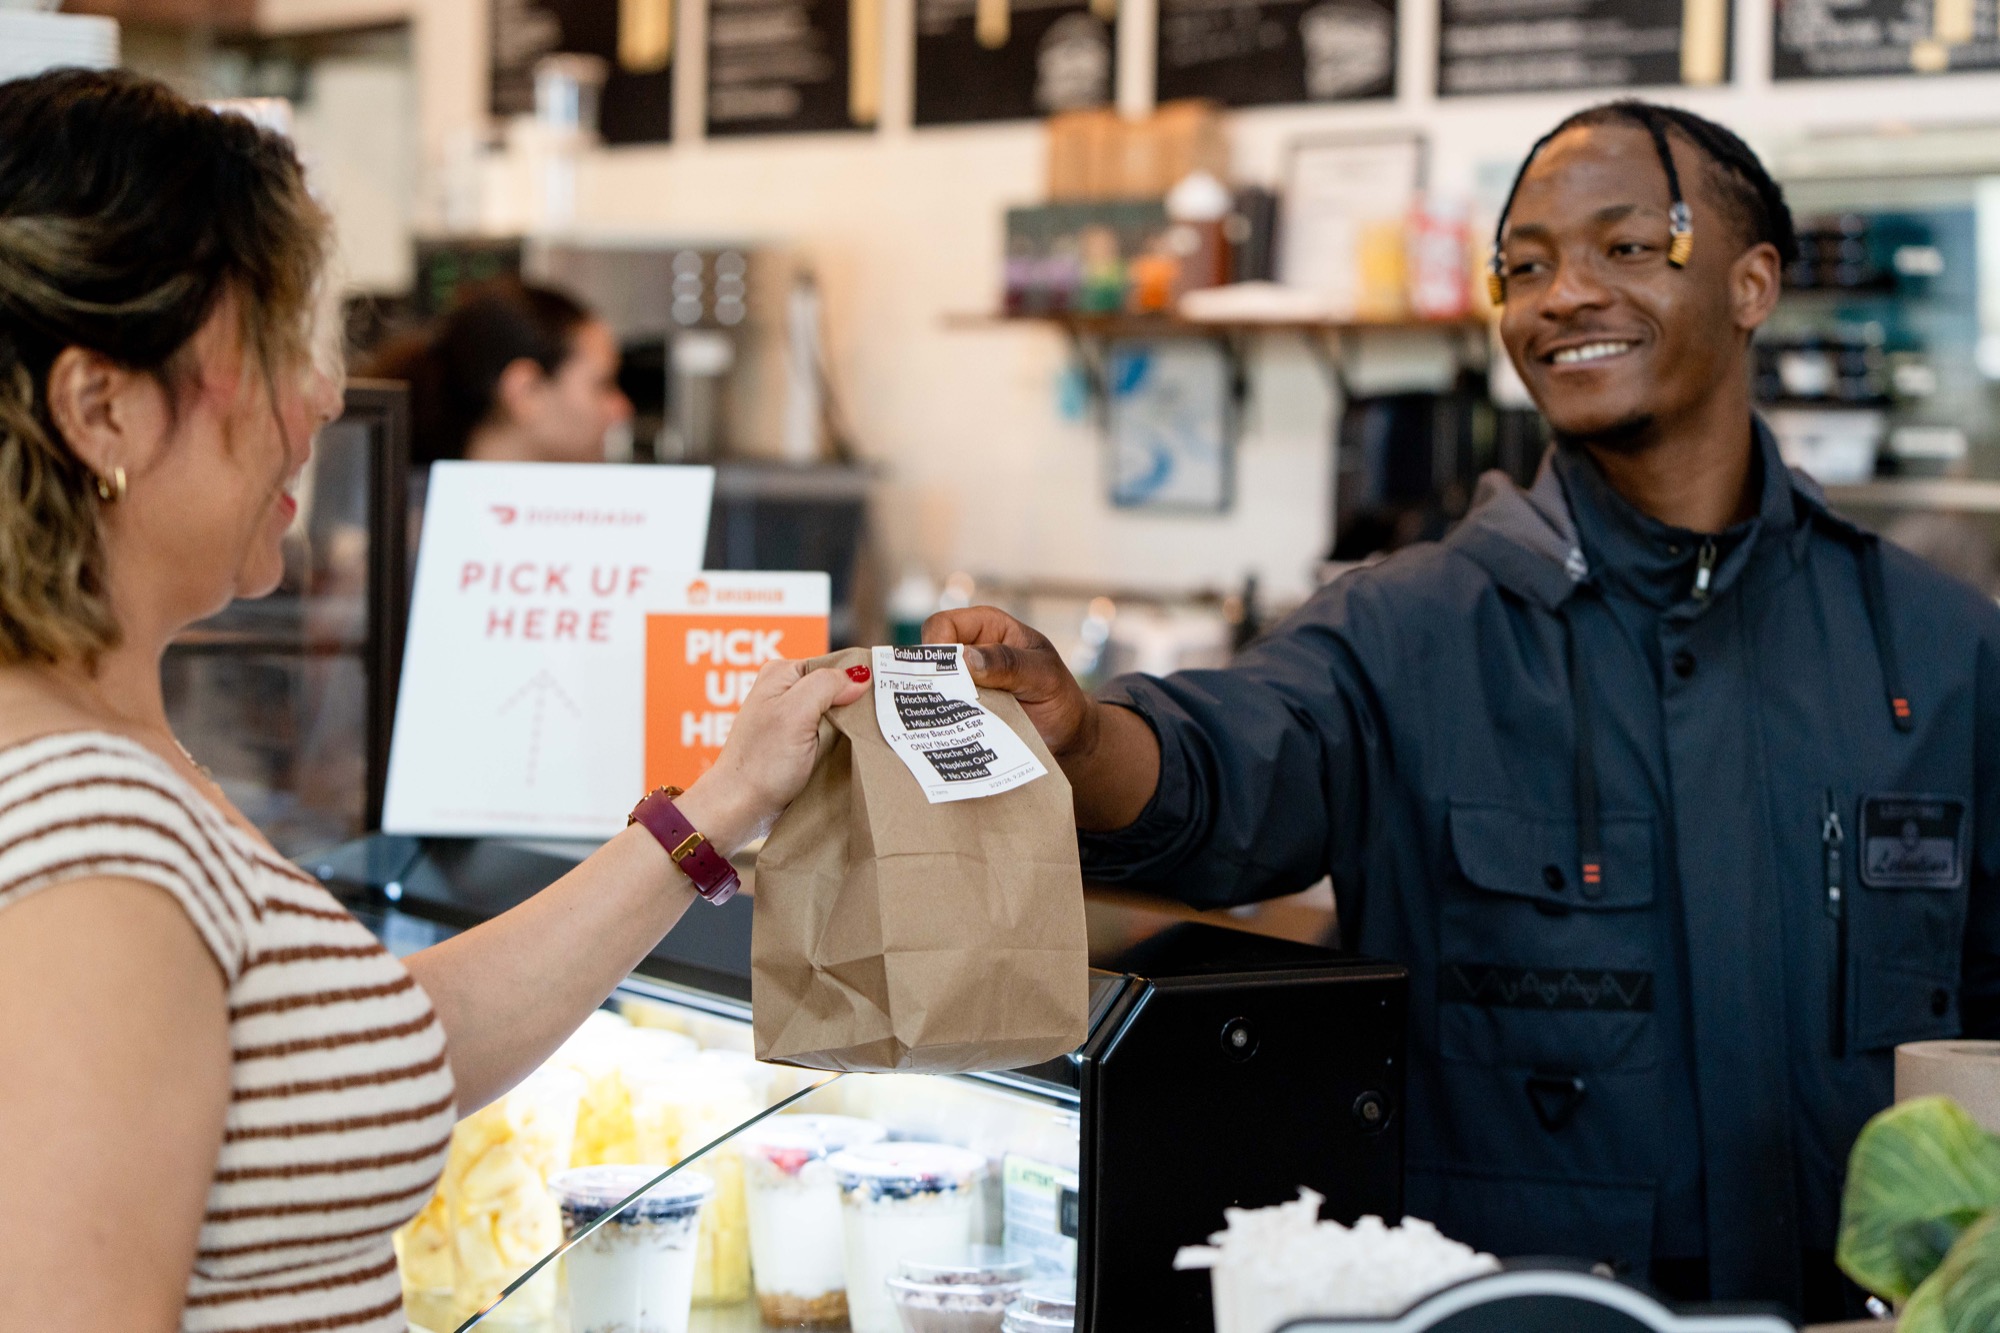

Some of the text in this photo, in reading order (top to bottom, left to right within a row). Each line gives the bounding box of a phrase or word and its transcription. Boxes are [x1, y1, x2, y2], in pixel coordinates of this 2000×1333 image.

[459, 561, 571, 595] PICK
[486, 608, 613, 642] HERE
[685, 629, 785, 665] PICK
[894, 647, 923, 660] Grubhub
[889, 680, 899, 690] The
[900, 681, 933, 692] "Lafayette"
[900, 695, 928, 705] Brioche
[928, 694, 943, 703] Roll
[904, 707, 936, 717] Cheddar
[936, 700, 969, 714] Cheese
[910, 719, 936, 729] Mike's
[936, 716, 952, 727] Hot
[953, 708, 982, 720] Honey
[903, 732, 930, 741] Turkey
[930, 728, 956, 738] Bacon
[956, 725, 965, 733] &
[965, 719, 984, 729] Egg
[910, 730, 985, 751] ONLY (No Cheese)
[932, 750, 963, 760] Brioche
[963, 744, 982, 755] Roll
[940, 760, 973, 771] Napkins
[973, 752, 995, 765] Only
[948, 771, 960, 780] No
[960, 768, 989, 779] Drinks
